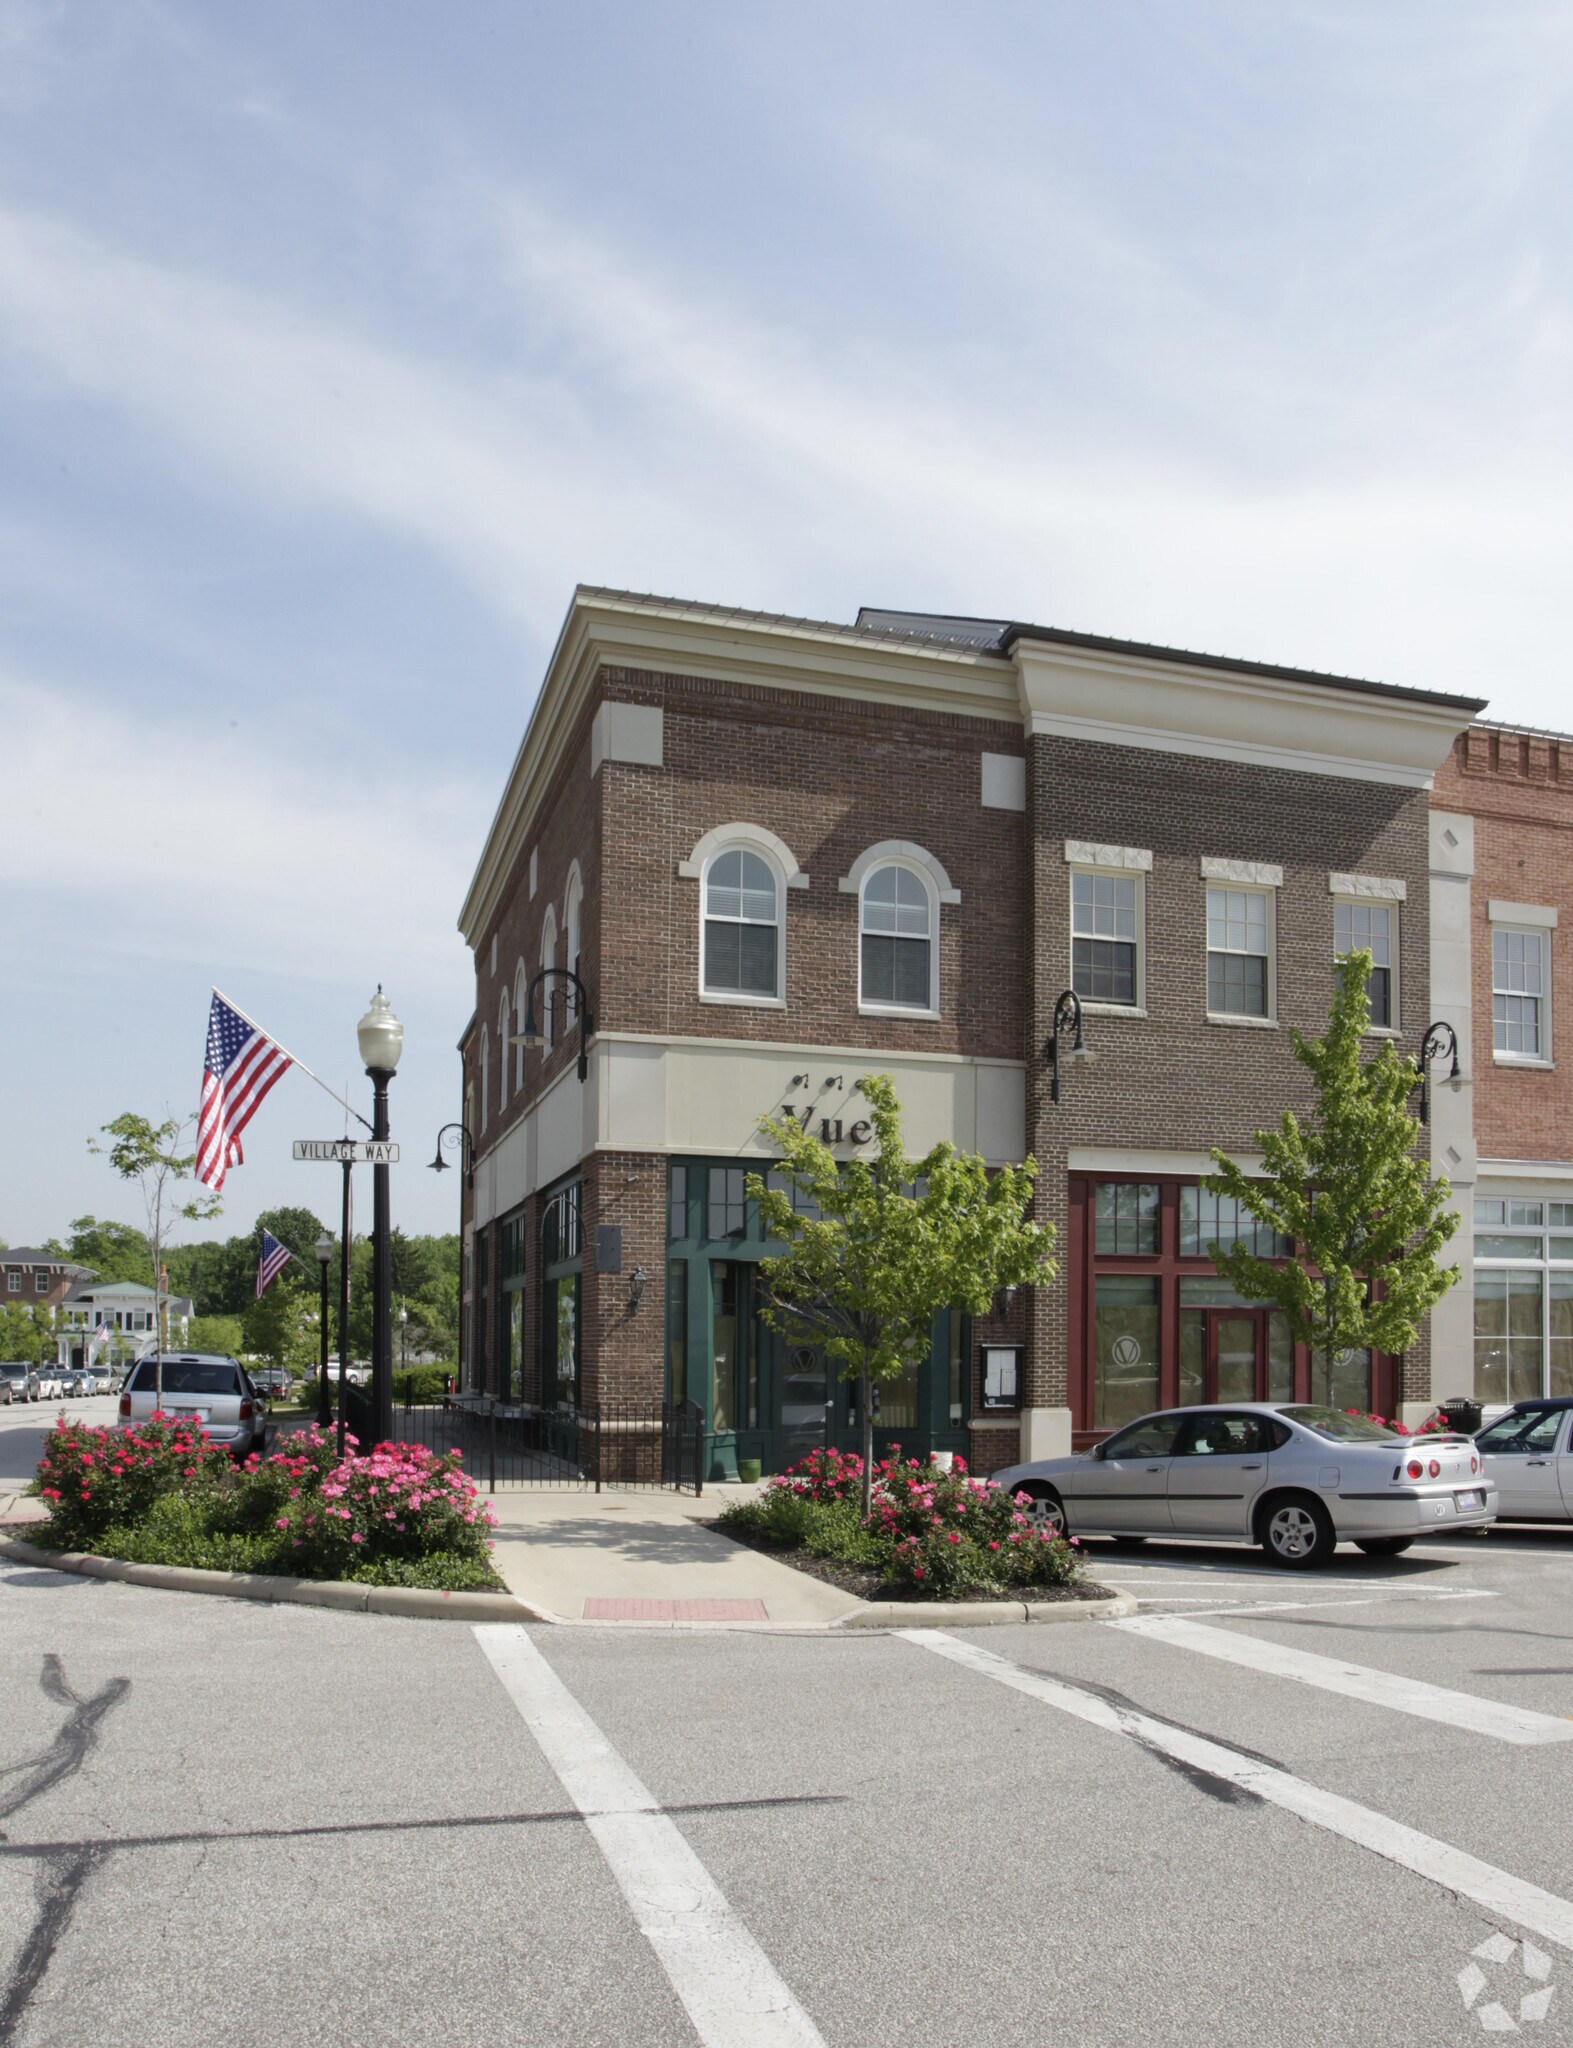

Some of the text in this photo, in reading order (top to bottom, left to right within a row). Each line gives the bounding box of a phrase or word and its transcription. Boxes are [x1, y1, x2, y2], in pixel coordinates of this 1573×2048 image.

[781, 1105, 873, 1145] Vue
[301, 1143, 392, 1160] VILLAGE WAY
